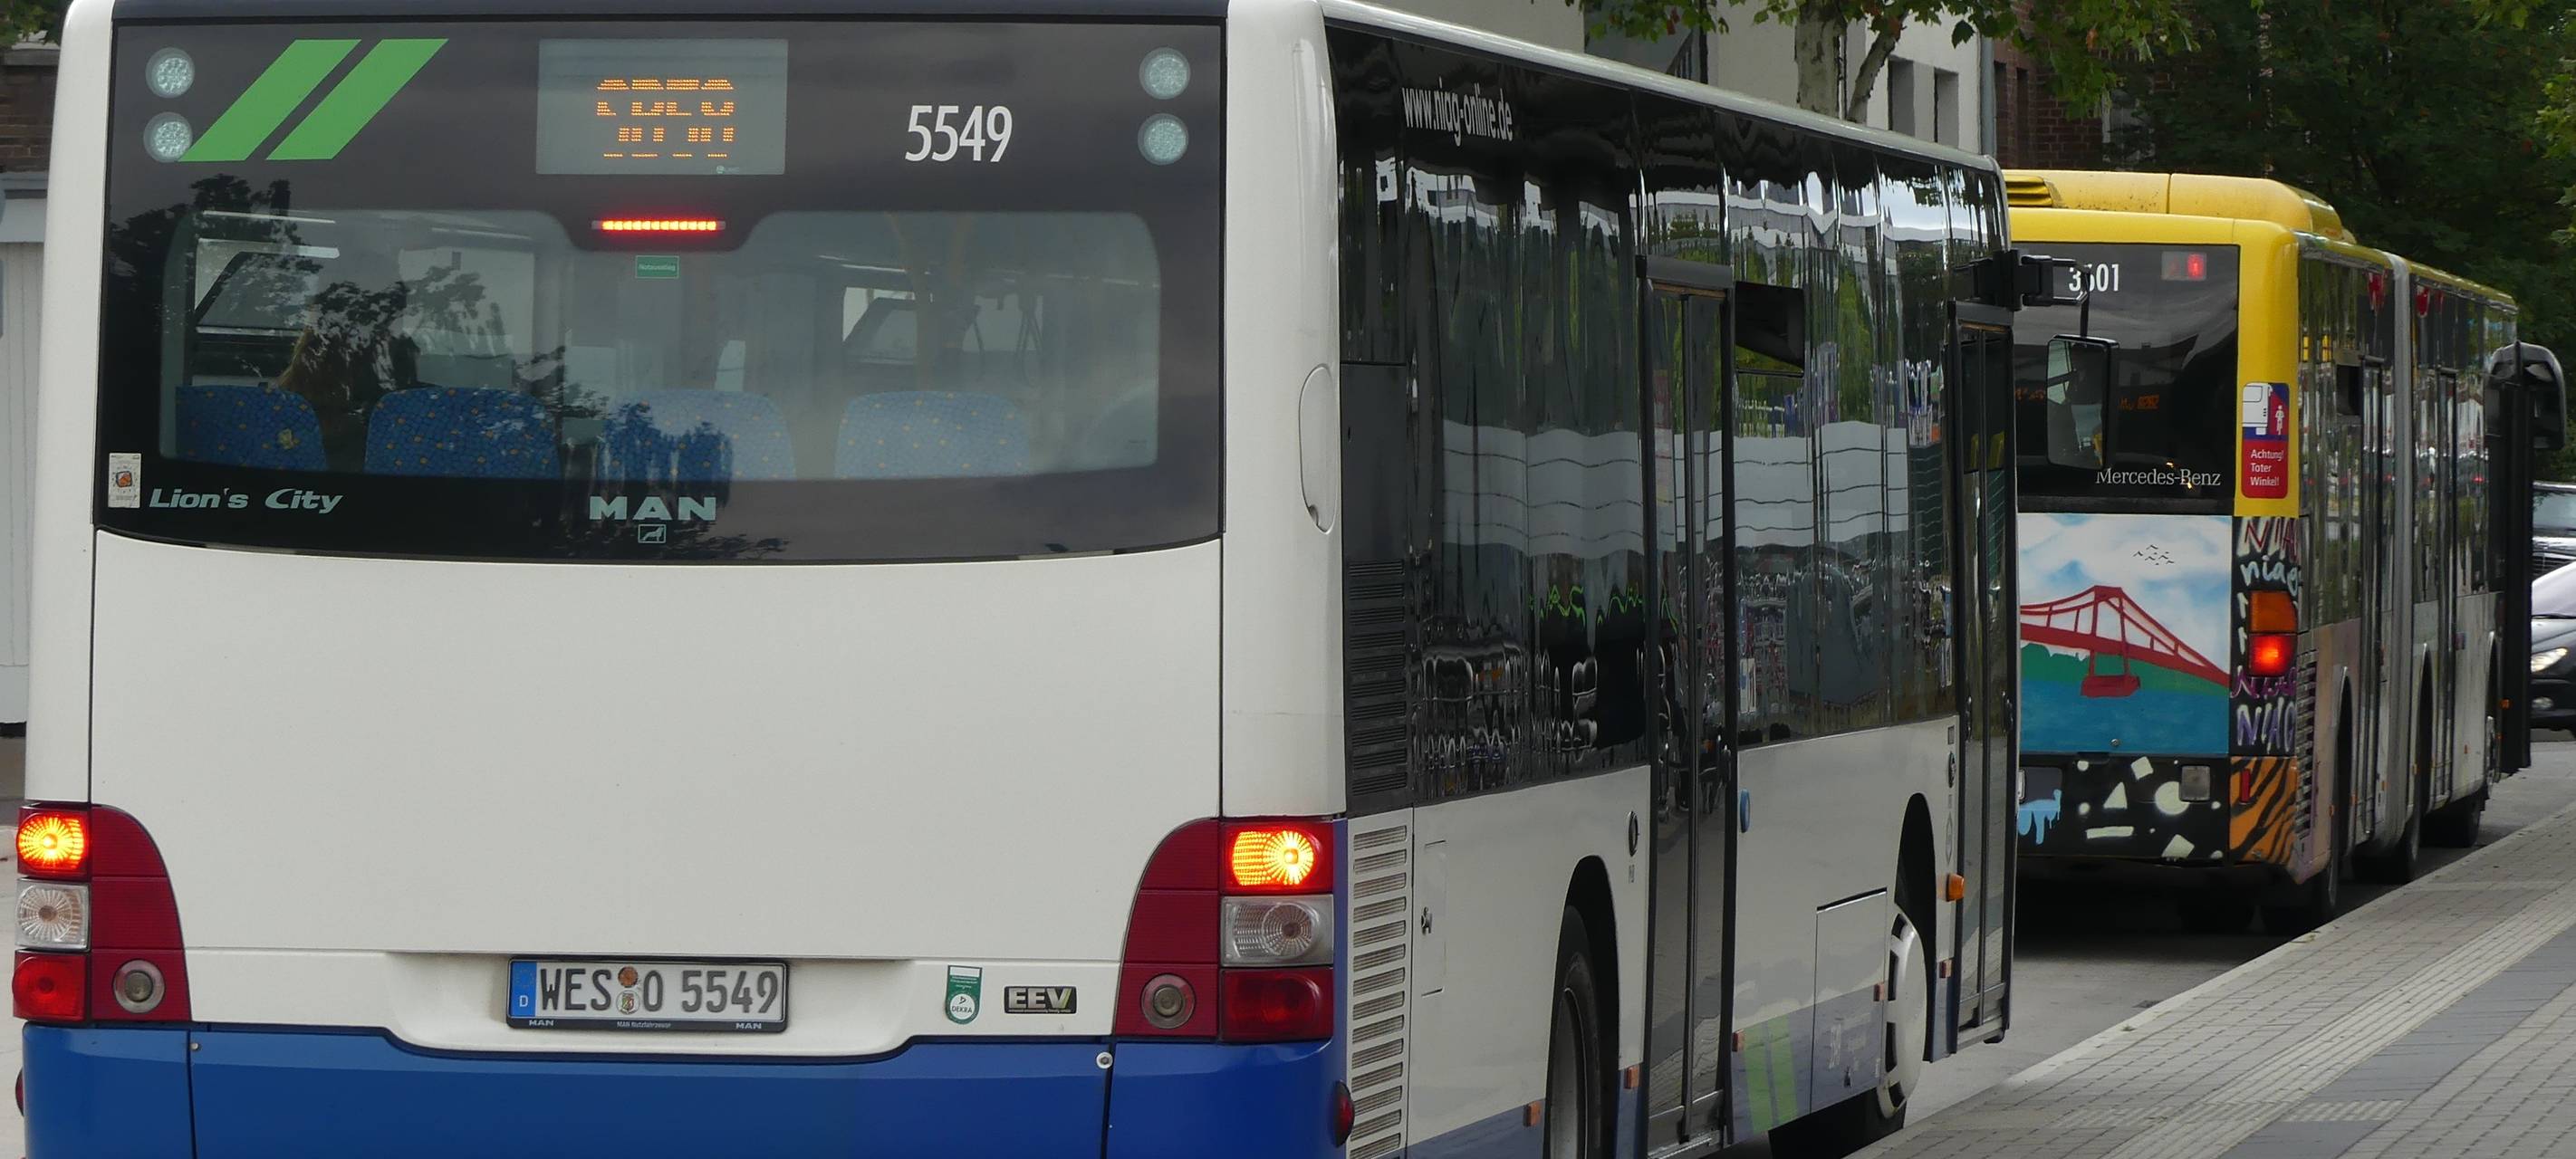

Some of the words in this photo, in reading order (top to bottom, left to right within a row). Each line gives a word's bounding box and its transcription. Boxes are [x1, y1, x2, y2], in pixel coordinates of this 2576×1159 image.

[1402, 76, 1513, 147] www.niag-online.de
[905, 104, 1013, 162] 5549
[2250, 449, 2284, 462] Achtung!
[2095, 467, 2221, 486] Mercedes-Benz
[2250, 463, 2272, 473] Toter
[149, 487, 249, 509] Lion's
[264, 487, 343, 514] City
[589, 495, 717, 521] MAN
[519, 995, 528, 1007] D
[541, 968, 612, 1011] WES
[681, 970, 779, 1014] 5549
[1008, 988, 1072, 1010] EEV
[952, 1005, 973, 1013] DEKRA
